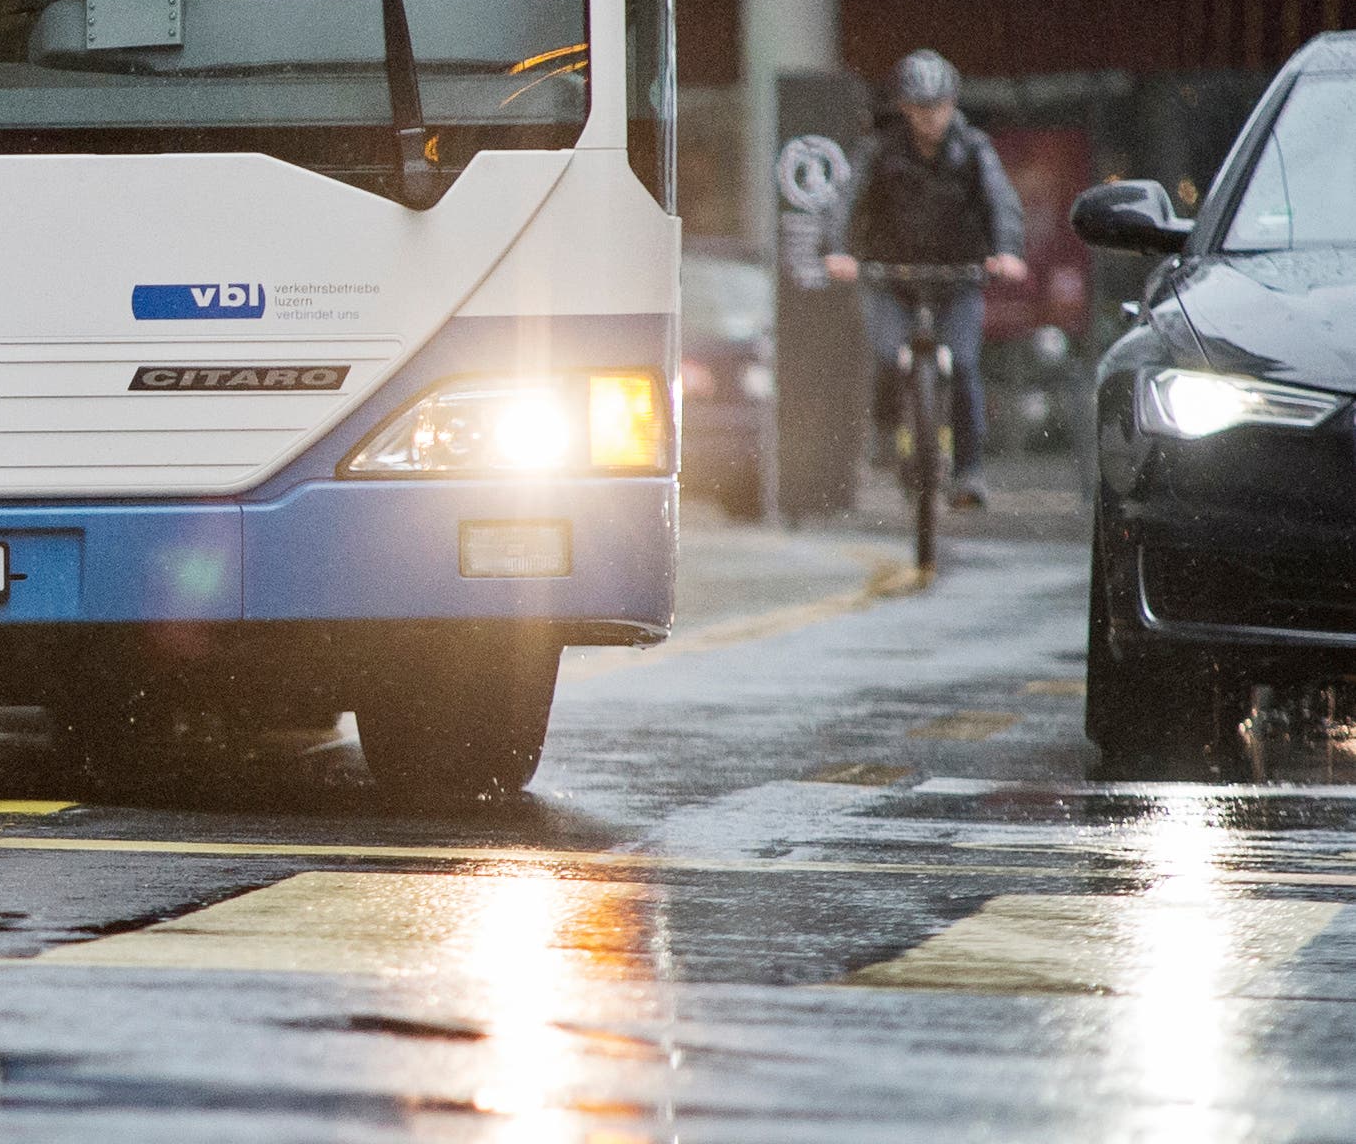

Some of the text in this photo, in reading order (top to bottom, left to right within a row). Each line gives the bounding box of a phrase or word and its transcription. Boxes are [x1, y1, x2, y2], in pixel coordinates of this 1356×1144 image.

[273, 282, 381, 294] verkehrsbetriebe
[190, 282, 260, 307] vbl
[273, 295, 313, 306] luzern
[275, 309, 361, 320] verbindet uns
[141, 368, 339, 387] CITARO
